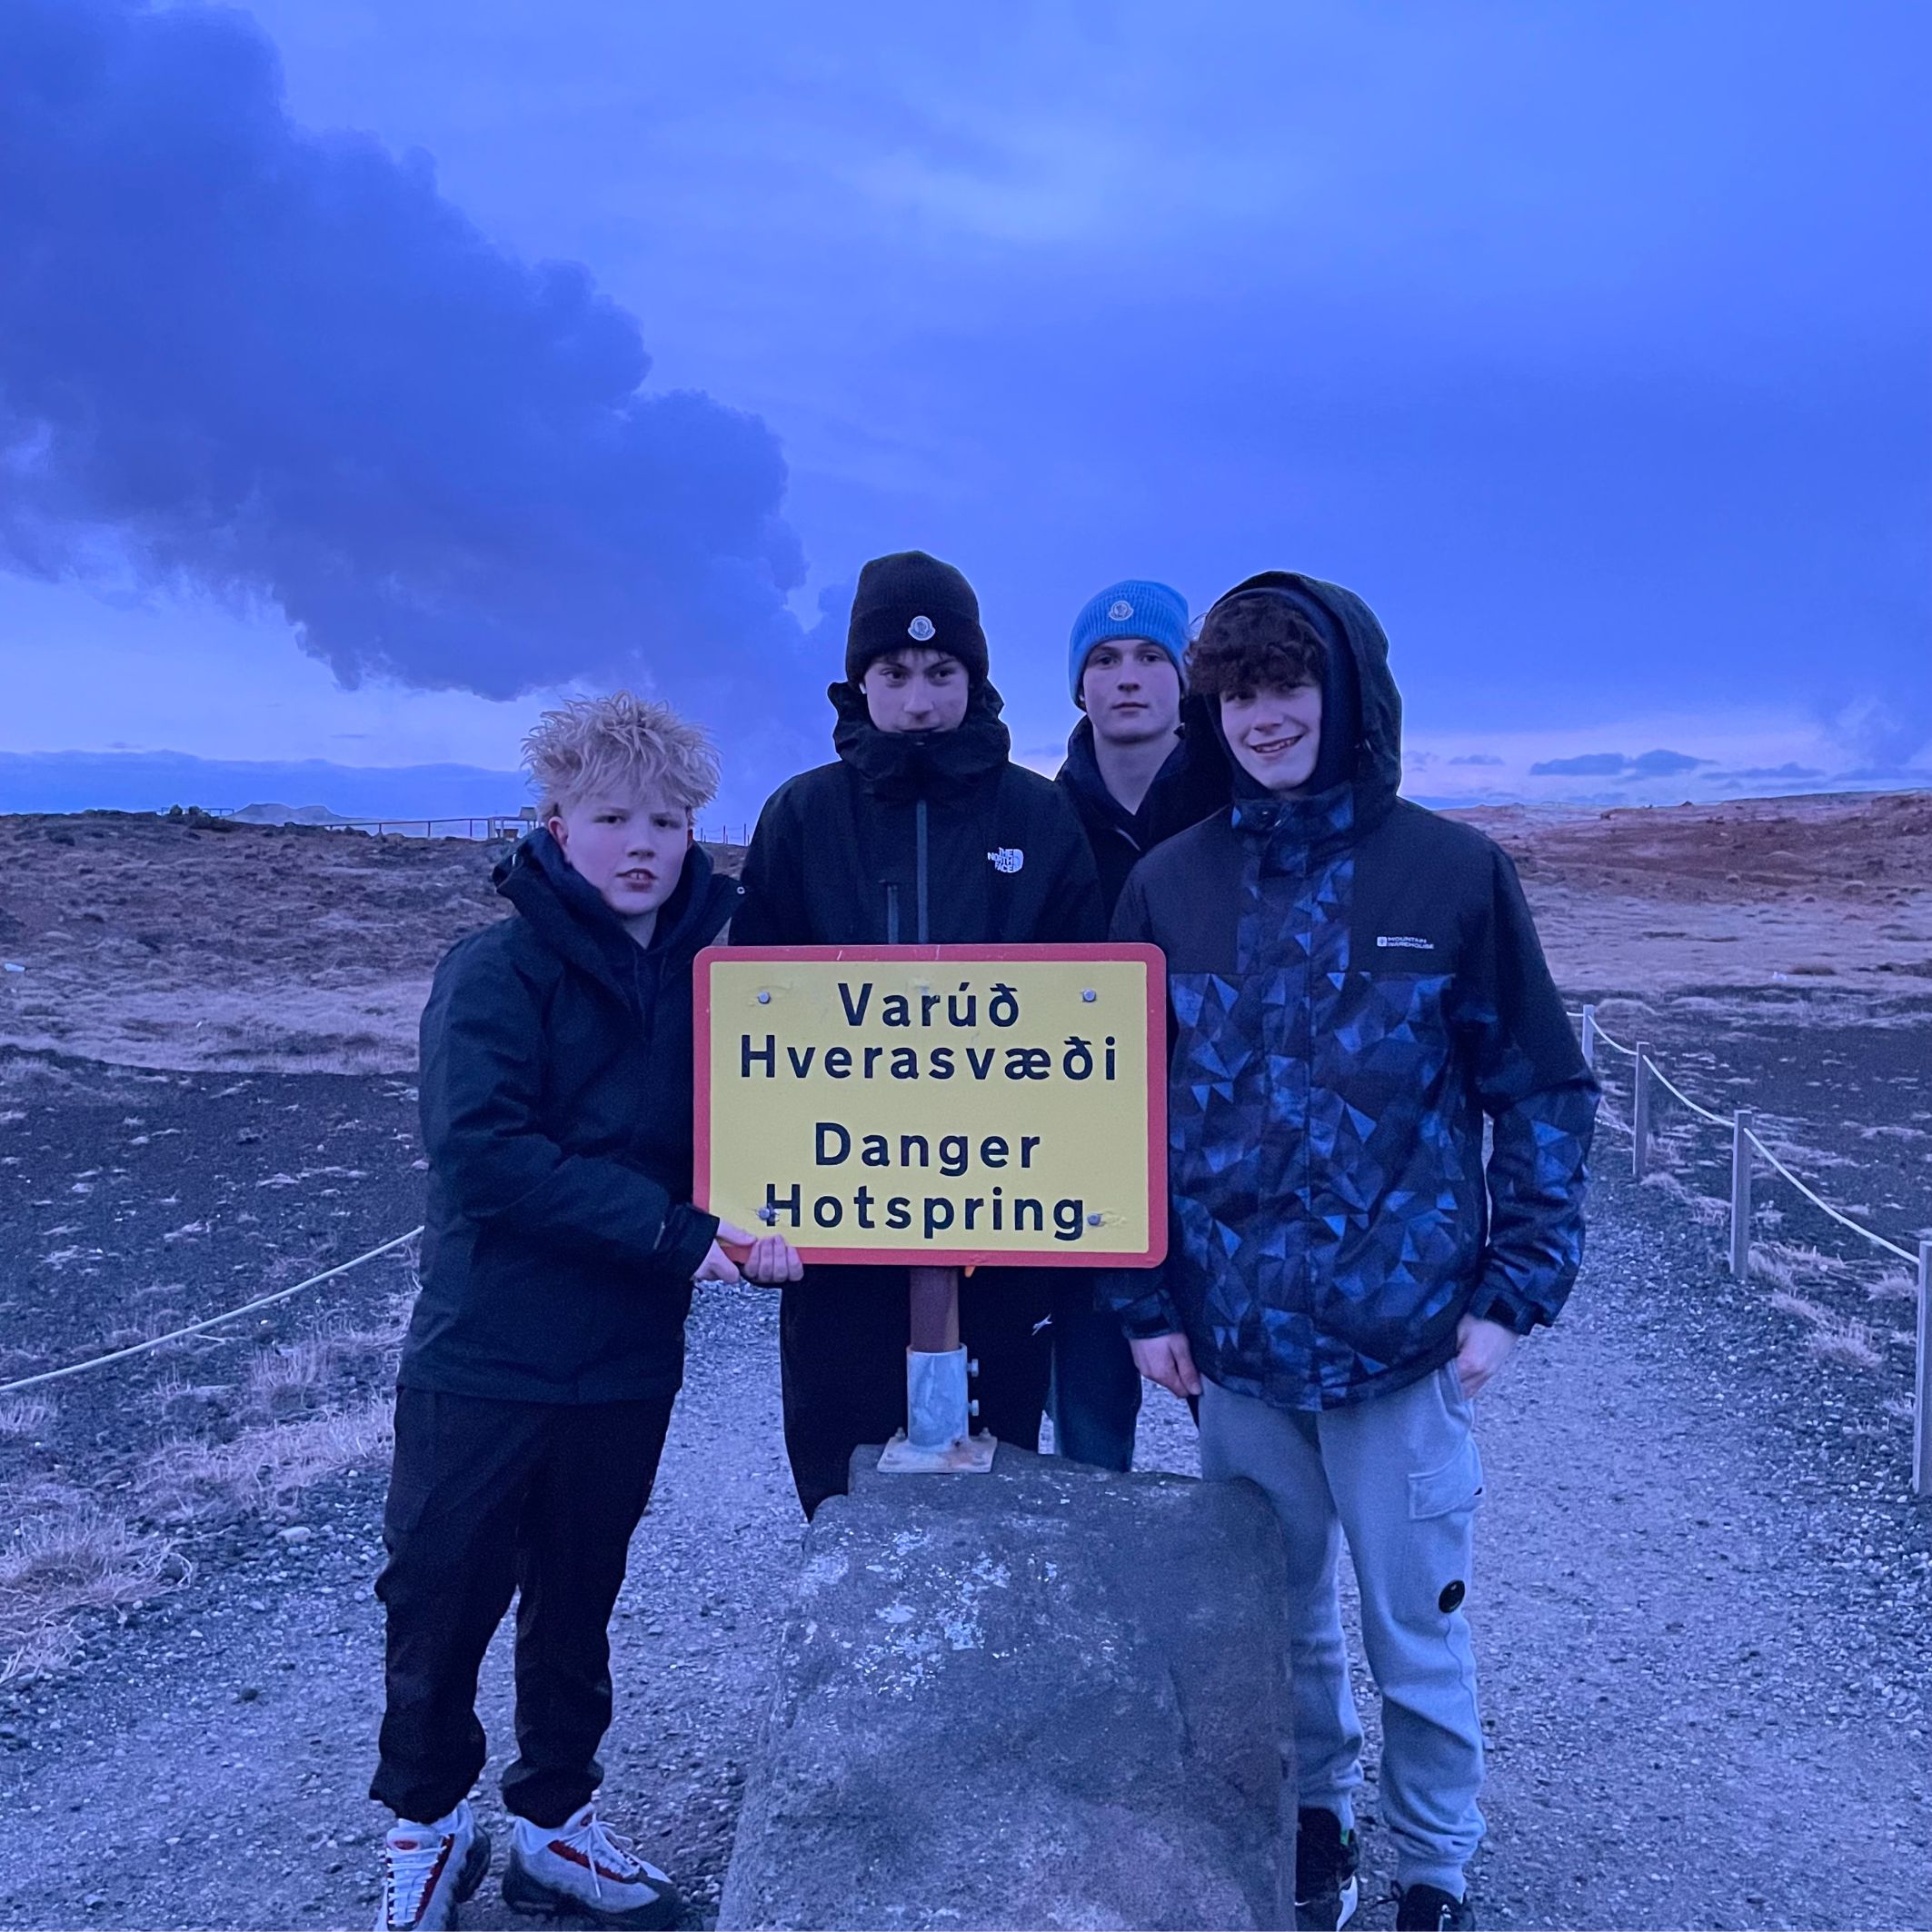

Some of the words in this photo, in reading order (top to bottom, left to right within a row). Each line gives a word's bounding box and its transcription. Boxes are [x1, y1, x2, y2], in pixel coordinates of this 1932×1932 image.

[995, 861, 1013, 872] FACE
[999, 847, 1013, 857] THE
[838, 982, 1020, 1027] Varúð
[741, 1034, 1116, 1081] Hverasvæði
[815, 1121, 1041, 1177] Danger
[766, 1183, 1084, 1241] Hotspring
